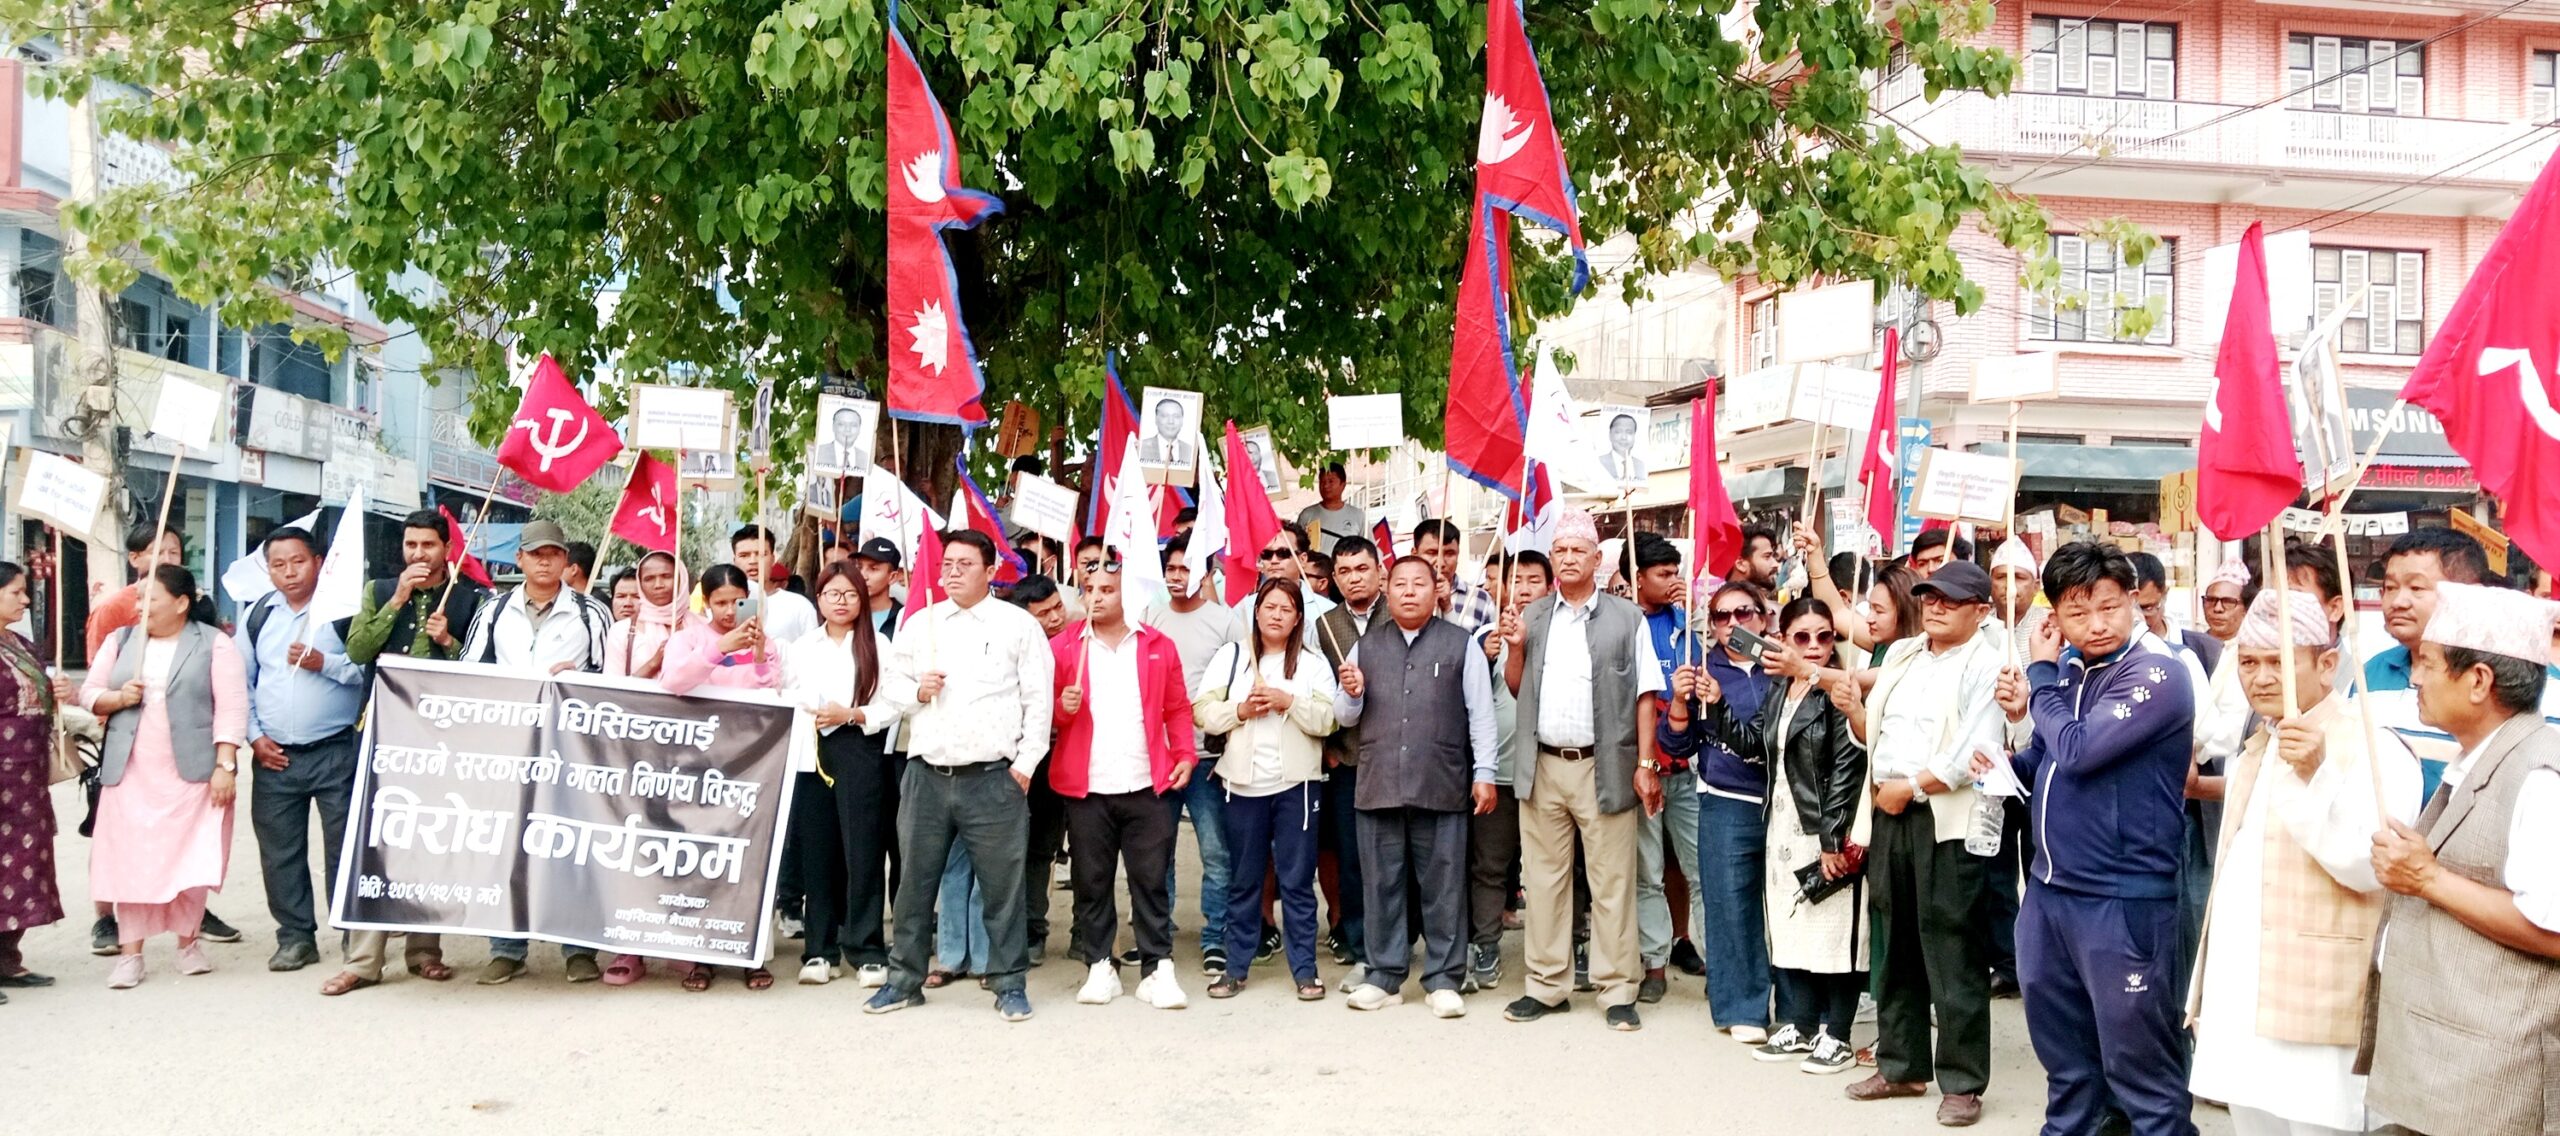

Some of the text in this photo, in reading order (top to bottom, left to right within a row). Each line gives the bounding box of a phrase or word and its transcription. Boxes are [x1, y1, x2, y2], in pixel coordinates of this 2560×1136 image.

[2346, 407, 2445, 434] MSUNG
[2424, 468, 2466, 486] chok
[417, 693, 720, 751] कुलमान घिसिङलाई
[371, 741, 450, 777] हटाउने
[454, 750, 564, 785] सरकारको
[566, 762, 628, 796] गलत
[630, 760, 698, 803] निर्णय
[368, 785, 751, 884] विरोध कार्यक्रम
[476, 884, 503, 906] गते
[704, 918, 746, 935] उदयपुर
[708, 937, 751, 954] उदयपुर
